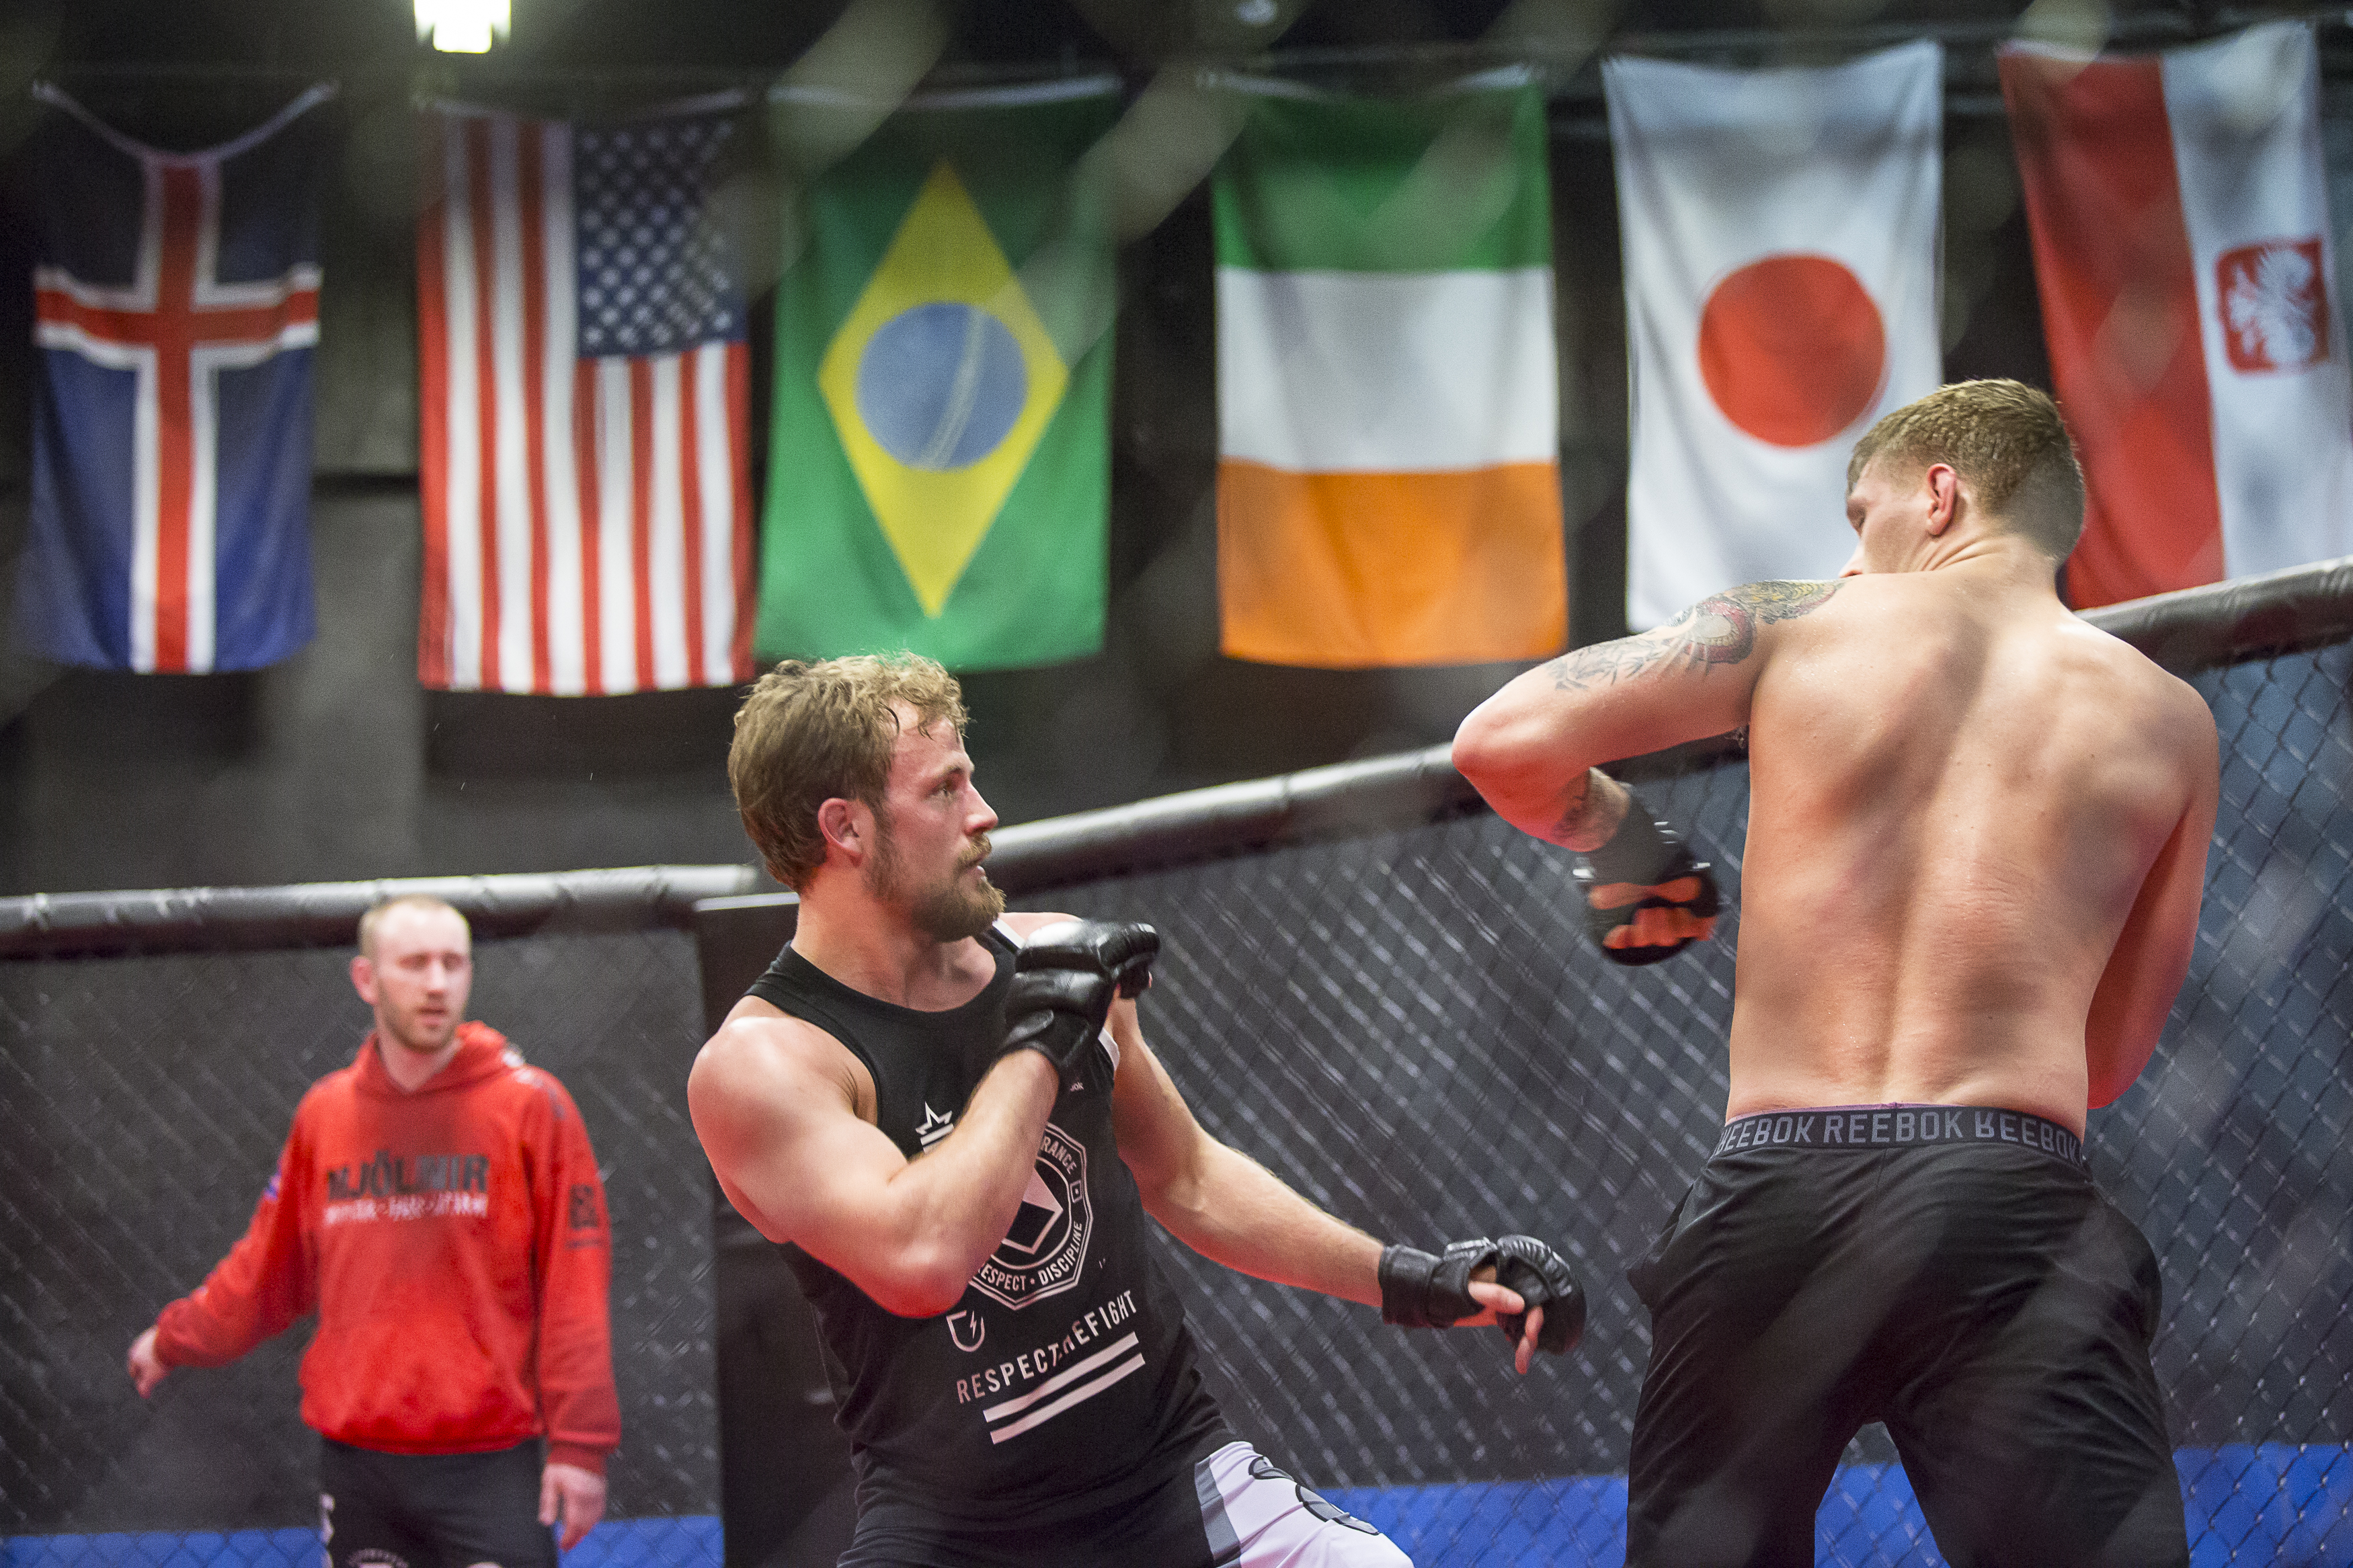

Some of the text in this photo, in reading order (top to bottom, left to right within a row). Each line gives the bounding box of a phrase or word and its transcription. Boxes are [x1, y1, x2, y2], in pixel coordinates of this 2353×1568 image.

[1823, 1110, 1963, 1143] REEBOK
[1975, 1110, 2081, 1167] REEBOK
[978, 1221, 1082, 1291] ESPECT DISCIPLINE
